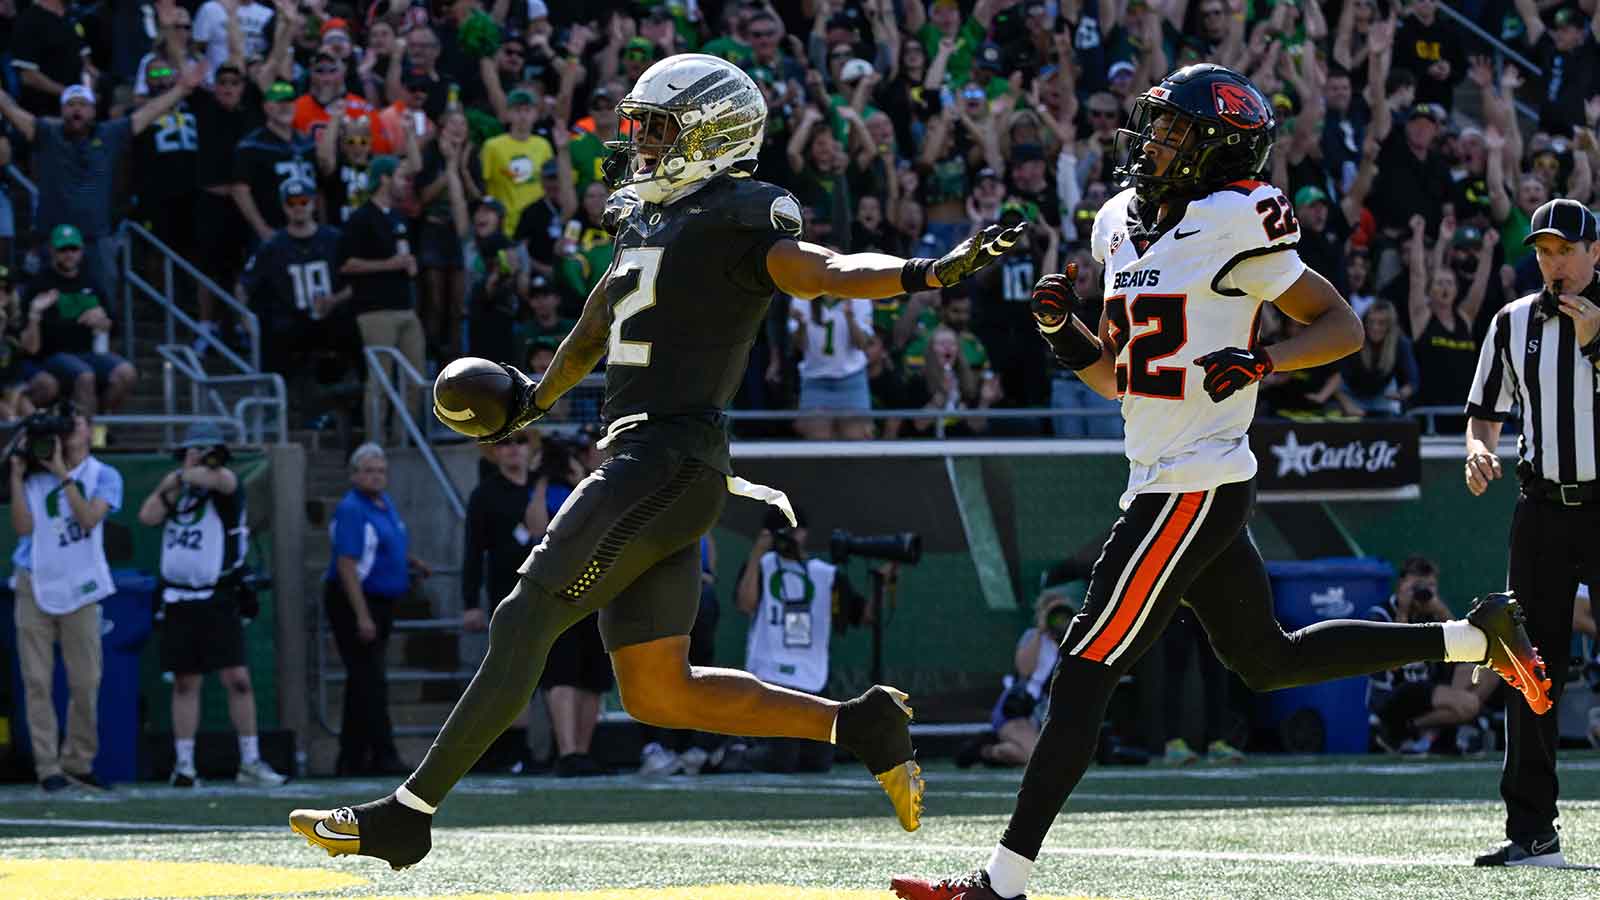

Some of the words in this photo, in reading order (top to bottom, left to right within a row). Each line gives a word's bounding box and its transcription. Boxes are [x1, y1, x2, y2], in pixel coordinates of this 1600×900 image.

[1256, 195, 1298, 241] 22
[1002, 262, 1034, 300] 10
[1113, 269, 1160, 290] BEAVS
[608, 247, 665, 368] 2
[822, 319, 835, 355] 1
[1104, 293, 1188, 400] 22
[1527, 339, 1539, 354] S
[1306, 440, 1364, 472] Carl's
